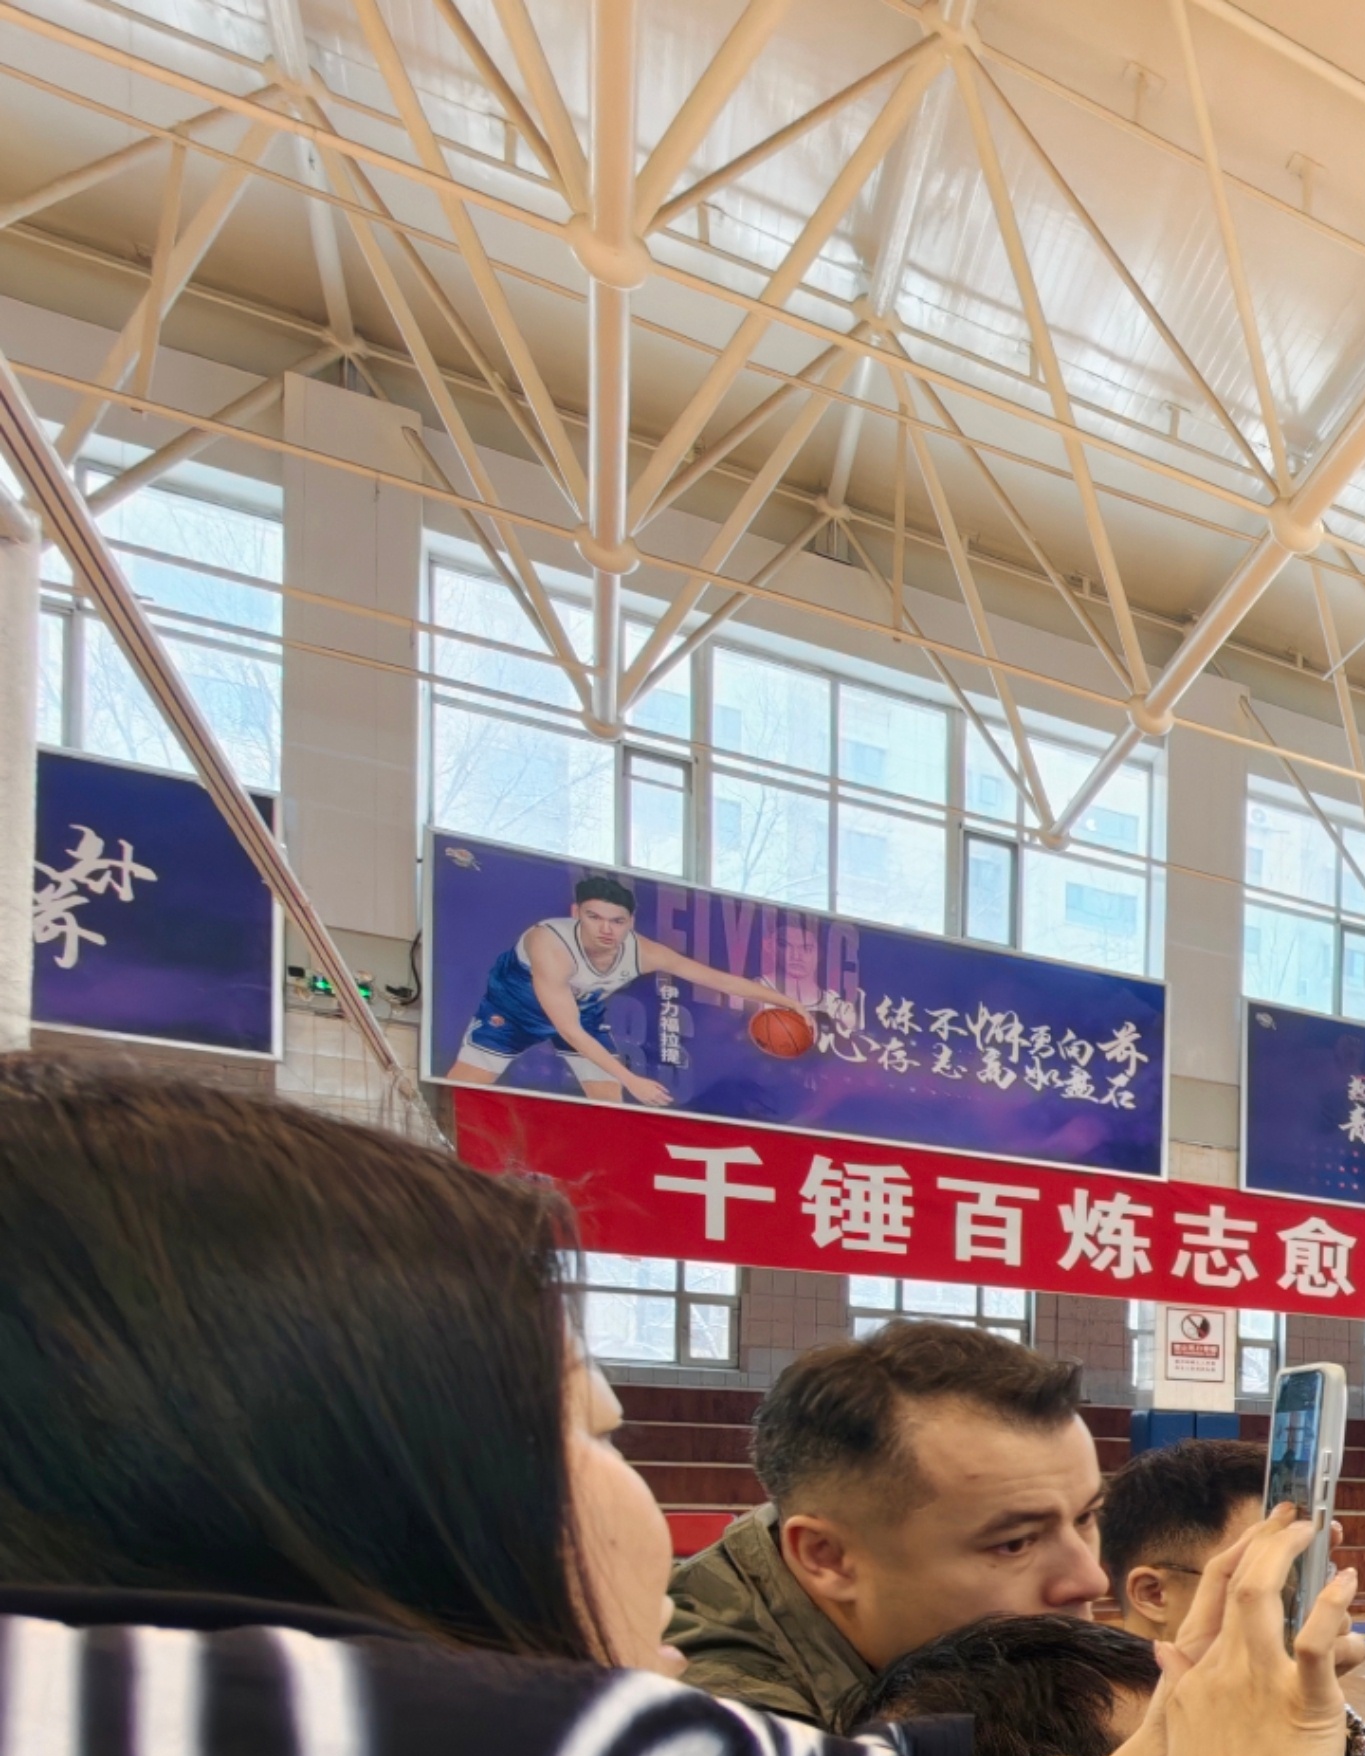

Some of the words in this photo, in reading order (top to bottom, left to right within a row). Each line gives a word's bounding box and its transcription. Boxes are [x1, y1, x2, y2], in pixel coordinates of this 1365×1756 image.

[658, 984, 682, 1065] 伊力福拉提
